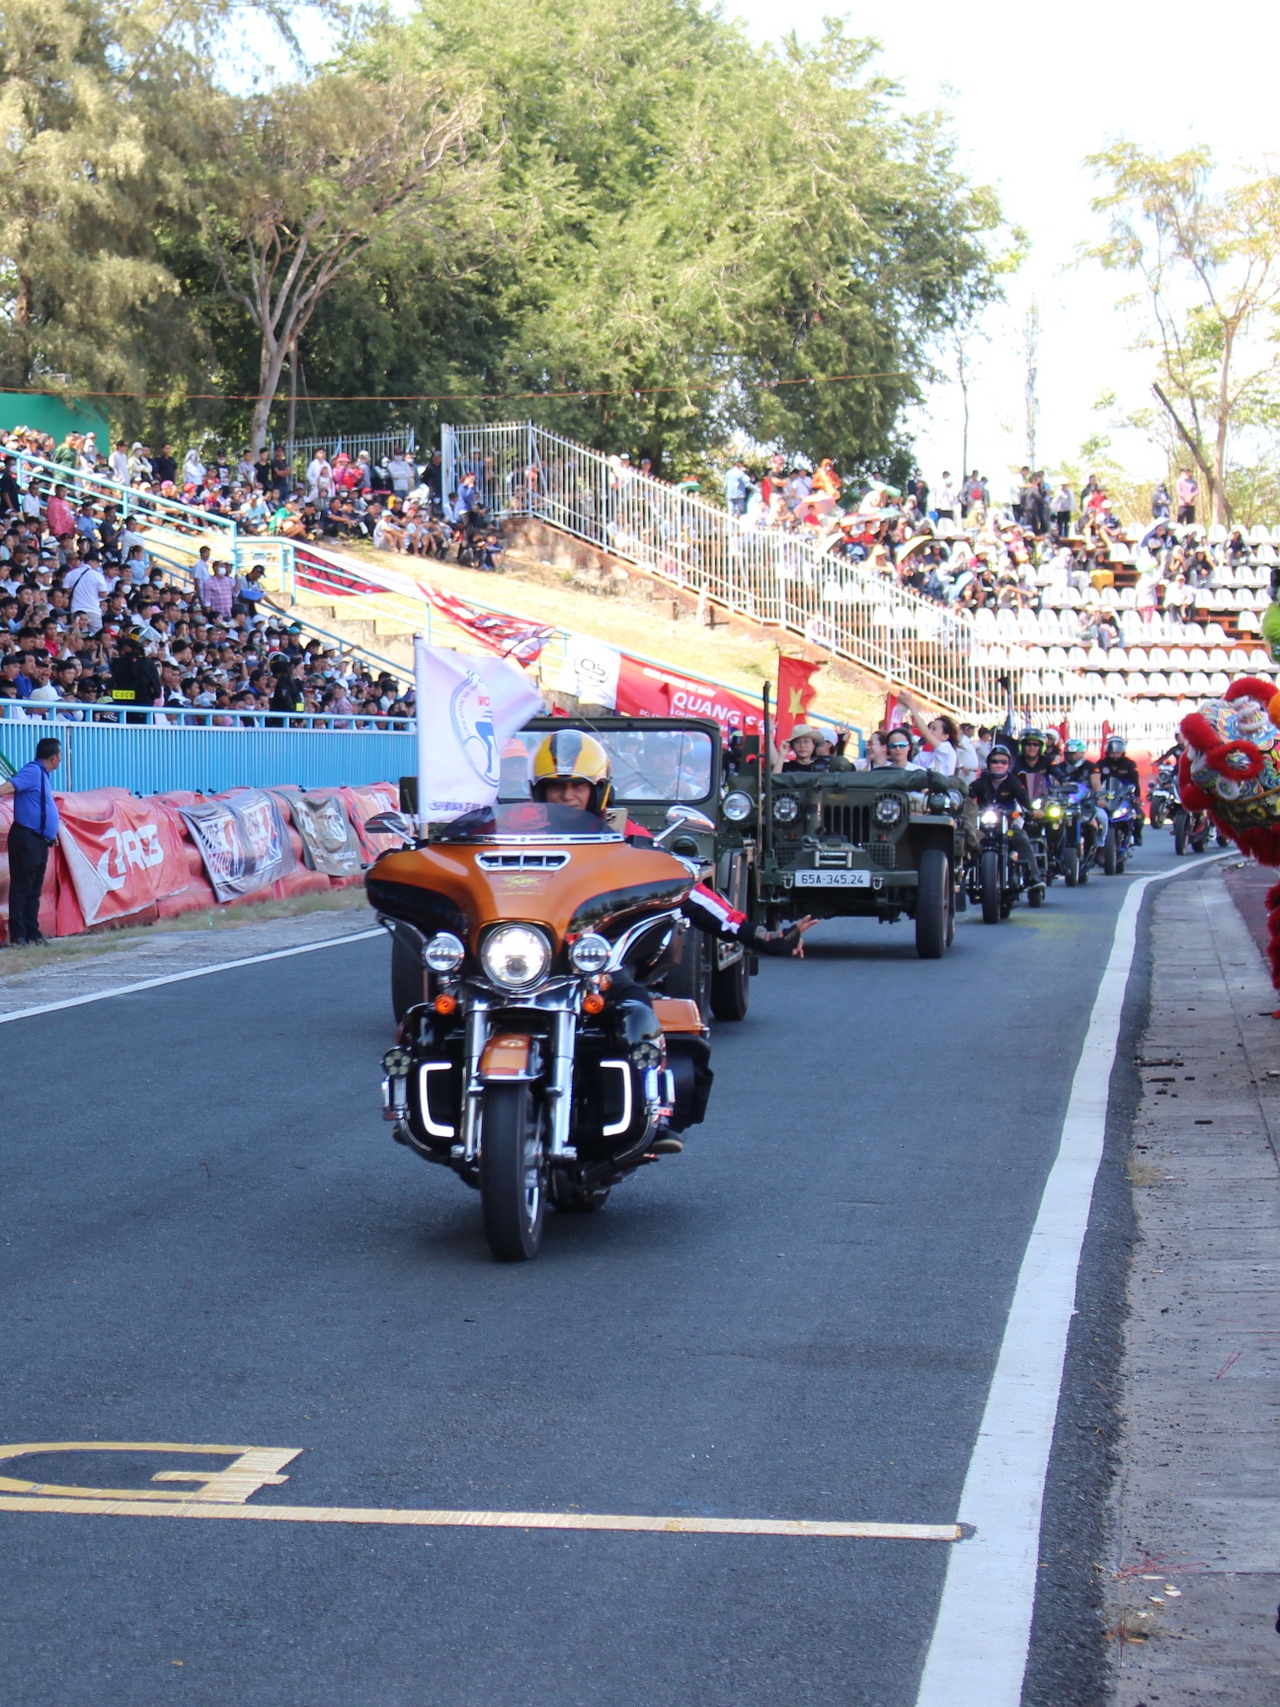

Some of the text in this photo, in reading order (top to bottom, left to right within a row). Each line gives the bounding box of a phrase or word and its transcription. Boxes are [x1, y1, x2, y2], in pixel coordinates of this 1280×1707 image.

[673, 692, 741, 725] QUANG
[121, 824, 164, 874] RCB
[801, 874, 864, 885] 65A-345.24
